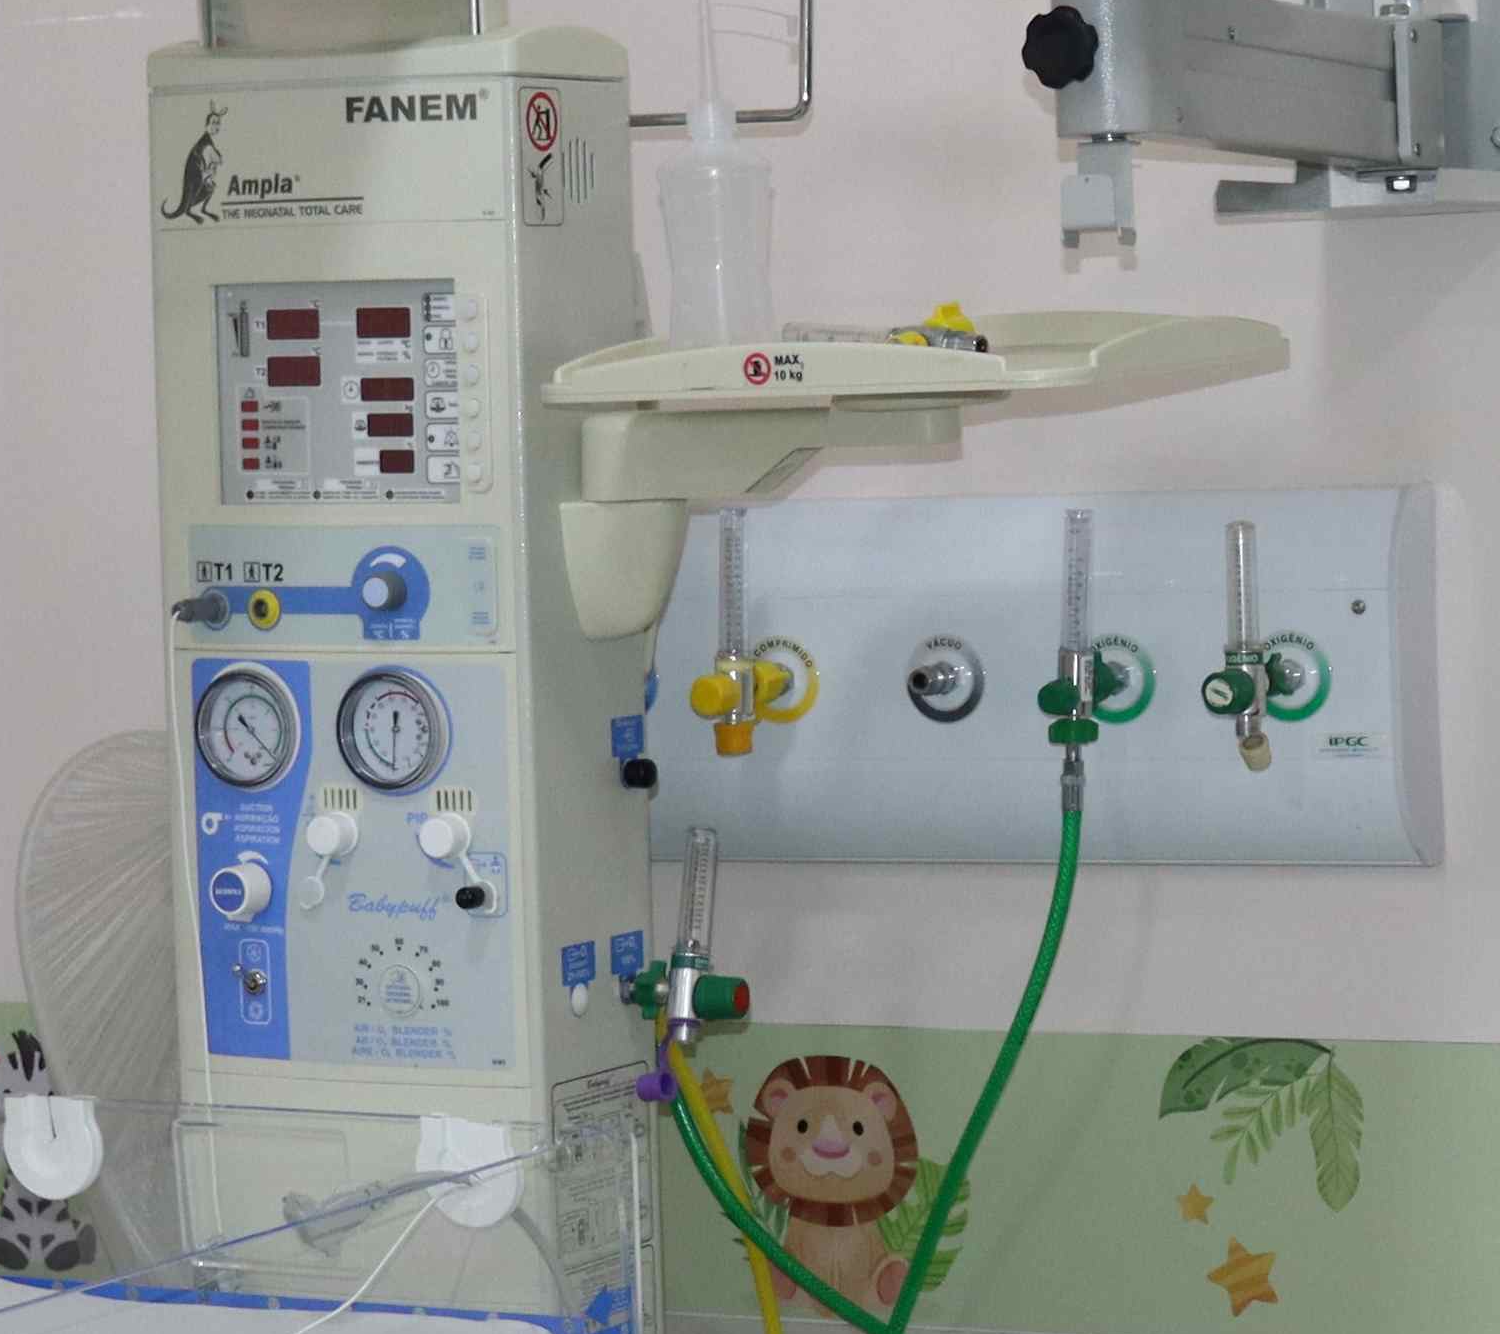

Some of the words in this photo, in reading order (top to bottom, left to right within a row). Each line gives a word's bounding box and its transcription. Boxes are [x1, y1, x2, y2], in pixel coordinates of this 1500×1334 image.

[222, 207, 242, 219] THE
[243, 205, 296, 219] NEONATAL
[298, 204, 331, 217] TOTAL
[333, 203, 364, 216] CARE
[774, 355, 799, 365] MAX
[775, 370, 786, 380] 10
[790, 370, 803, 382] kg
[214, 563, 233, 581] T1
[263, 564, 284, 582] T2
[754, 639, 813, 669] COMPRIMIDO
